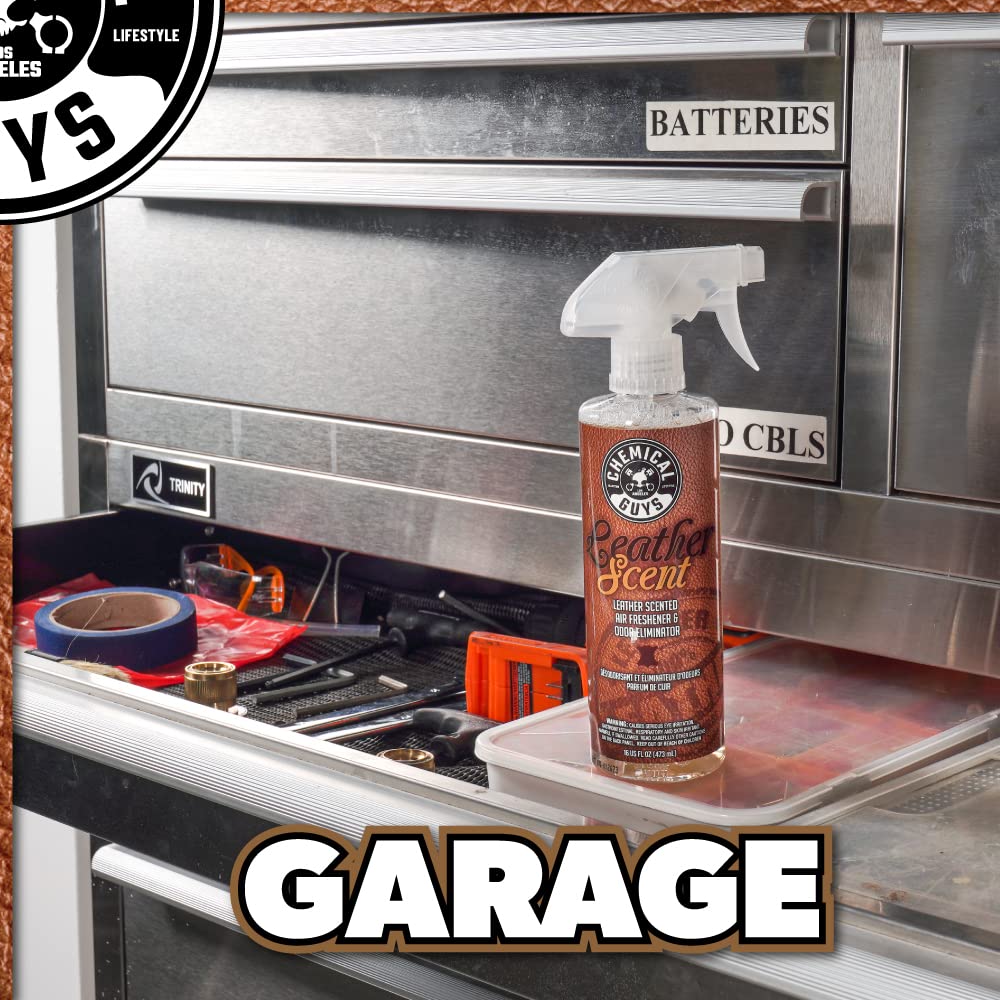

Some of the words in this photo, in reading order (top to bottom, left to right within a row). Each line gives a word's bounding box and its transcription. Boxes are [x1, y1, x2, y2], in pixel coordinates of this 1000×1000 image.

[649, 105, 829, 137] BATTERIES
[743, 423, 825, 459] CBLS
[607, 445, 675, 482] CHEMICAL
[169, 477, 205, 497] TRINITY
[619, 497, 664, 516] GUYS
[586, 518, 715, 569] Leather
[597, 553, 692, 595] Scent
[613, 599, 643, 611] LEATHER
[645, 599, 678, 611] SCENTED
[615, 612, 627, 623] AIR
[629, 613, 671, 625] FRESHENER
[673, 612, 679, 623] &
[614, 626, 633, 637] ODOR
[636, 625, 680, 638] ELIMINATOR
[626, 682, 648, 691] PARFUM
[650, 682, 657, 691] DE
[658, 682, 671, 691] CUIR
[641, 673, 676, 682] ÉLIMINATEUR
[637, 750, 644, 758] FL
